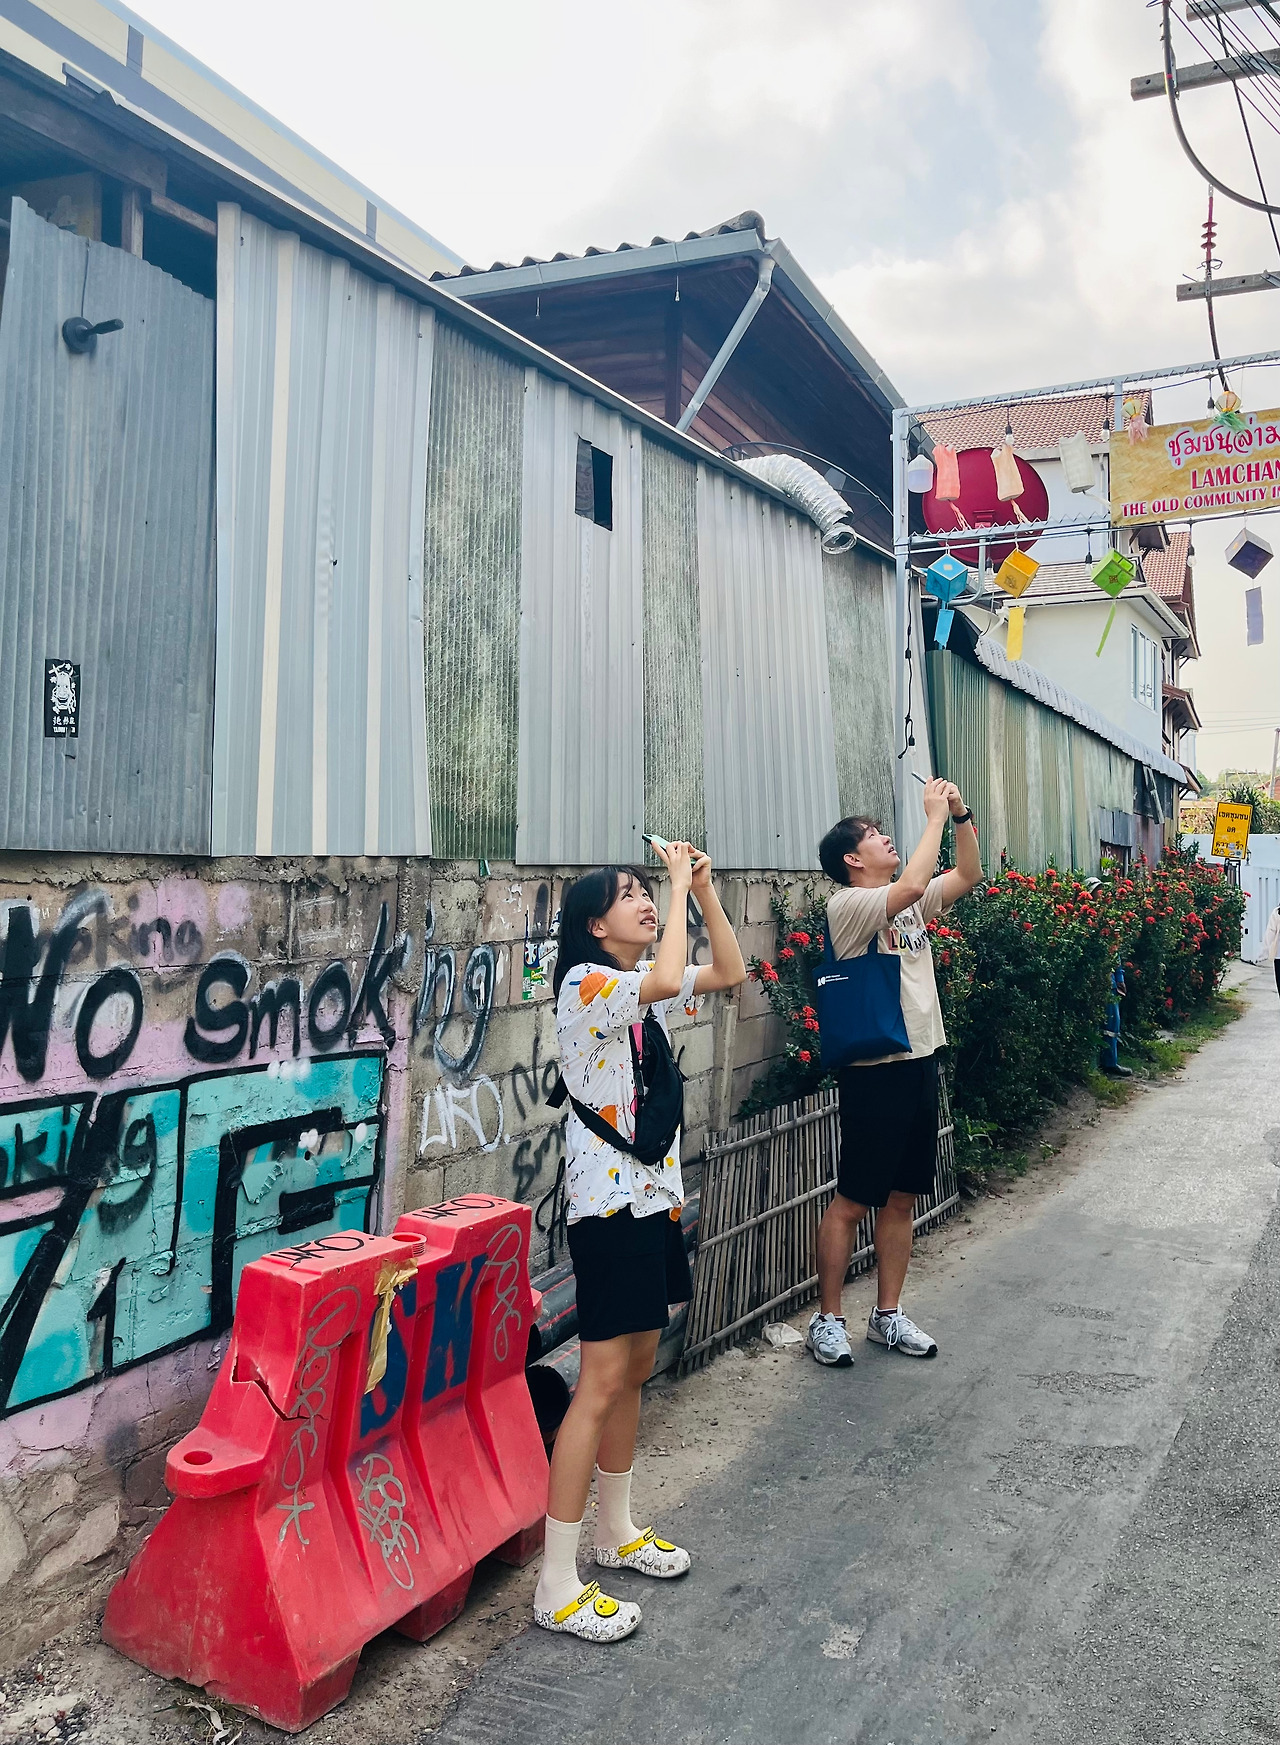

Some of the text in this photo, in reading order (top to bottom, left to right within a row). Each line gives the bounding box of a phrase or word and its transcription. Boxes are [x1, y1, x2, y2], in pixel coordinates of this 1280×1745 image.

[1122, 502, 1147, 517] THE
[1152, 498, 1180, 513] OLD
[1184, 487, 1267, 509] COMMUNITY
